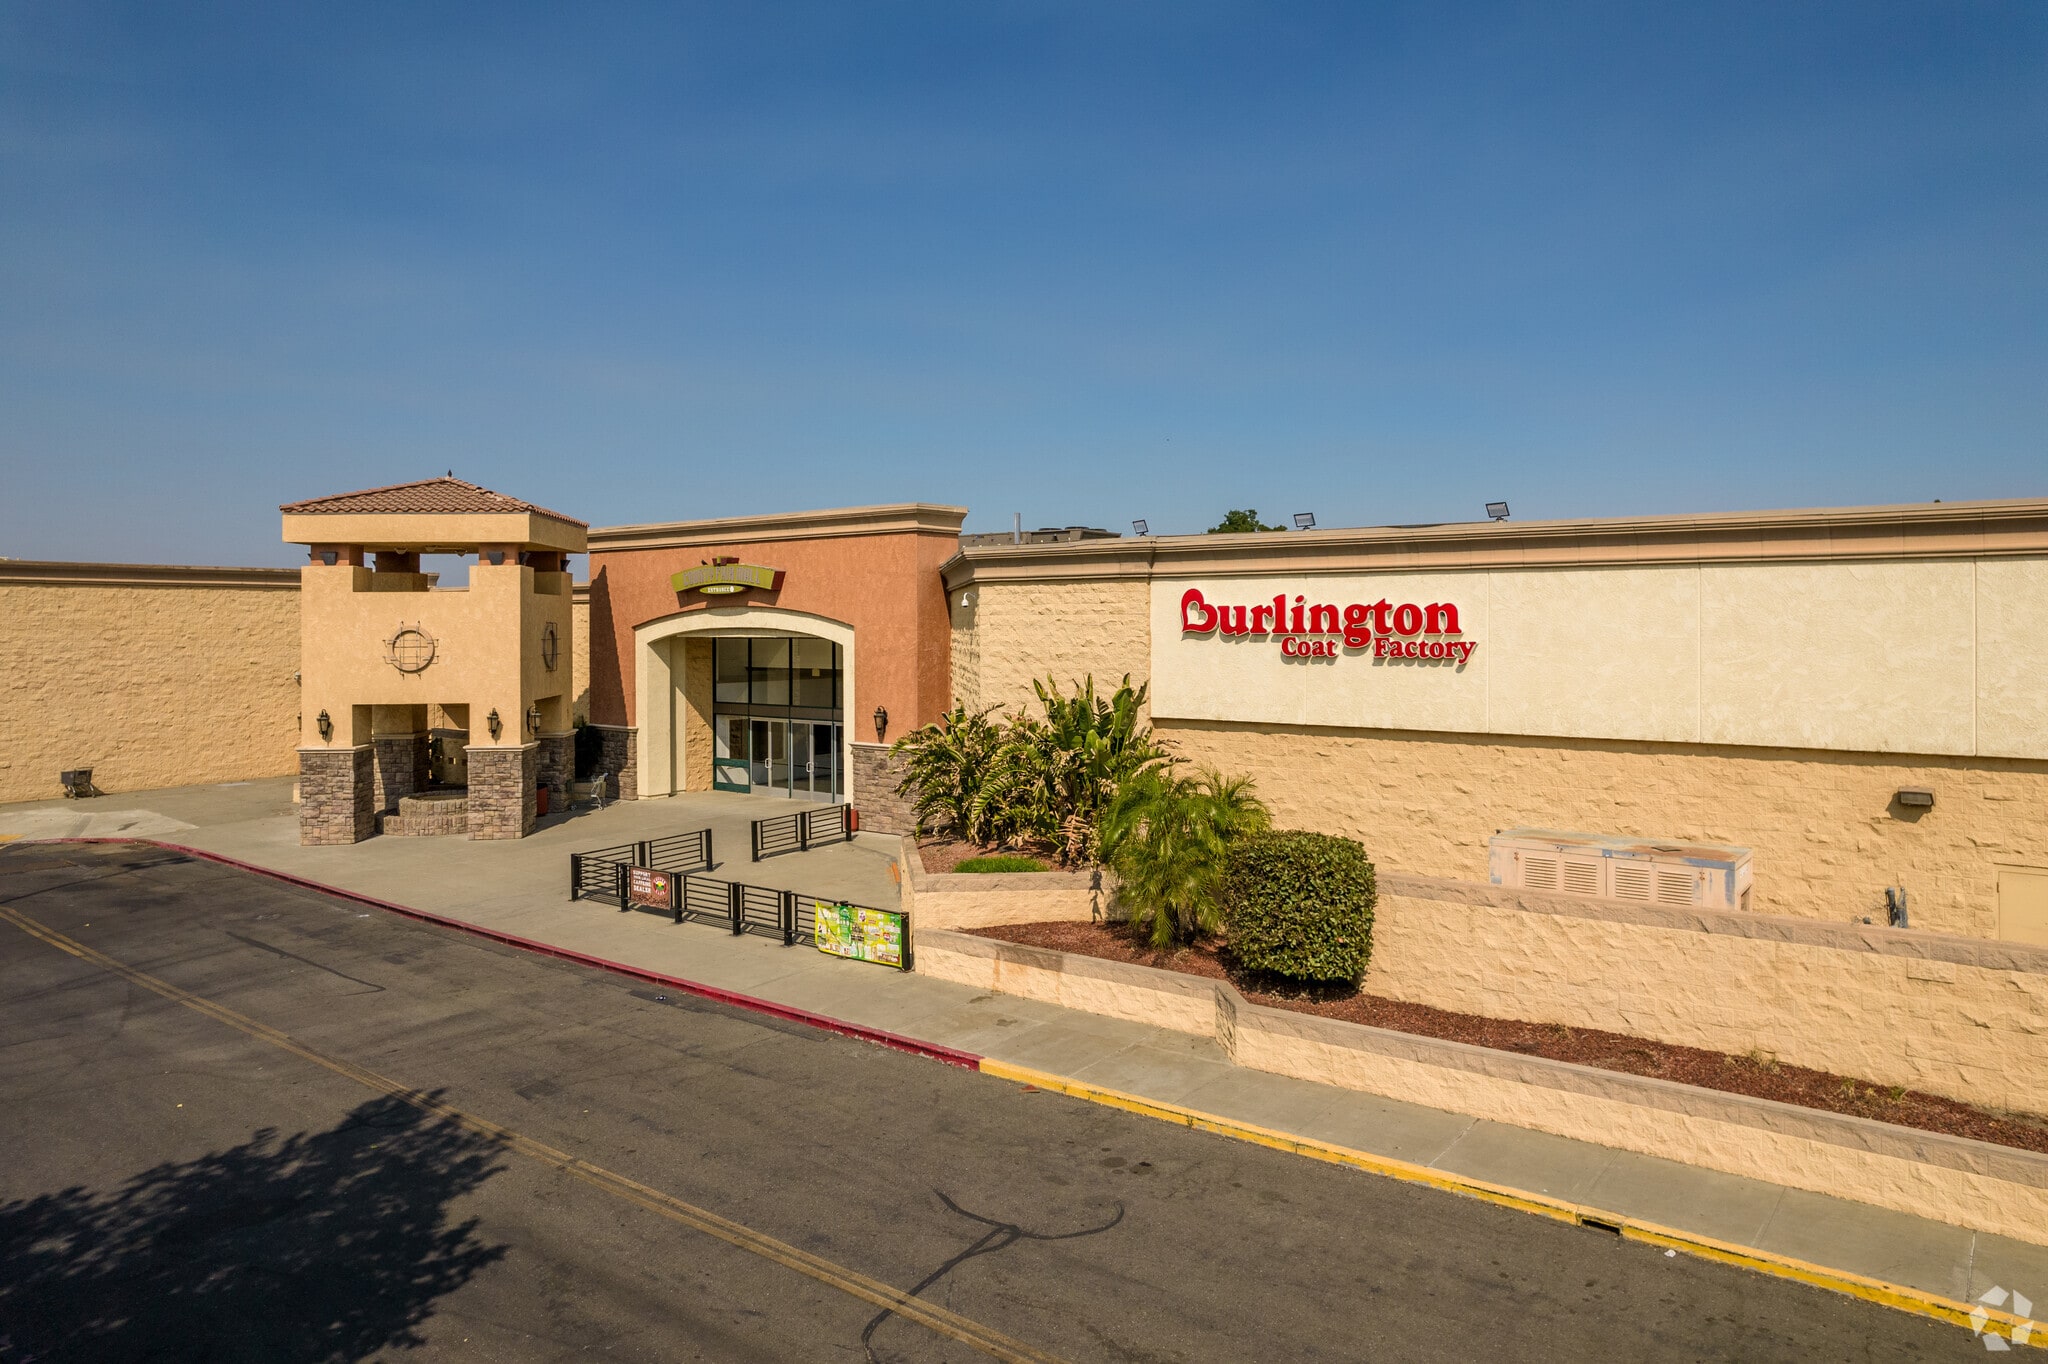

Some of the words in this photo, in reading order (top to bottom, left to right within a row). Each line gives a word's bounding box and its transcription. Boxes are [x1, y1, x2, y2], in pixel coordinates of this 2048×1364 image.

[736, 567, 761, 585] MALL
[1181, 588, 1462, 648] Burlington
[1281, 637, 1338, 658] Coat
[1374, 637, 1478, 665] Factory
[633, 885, 651, 894] DEALER
